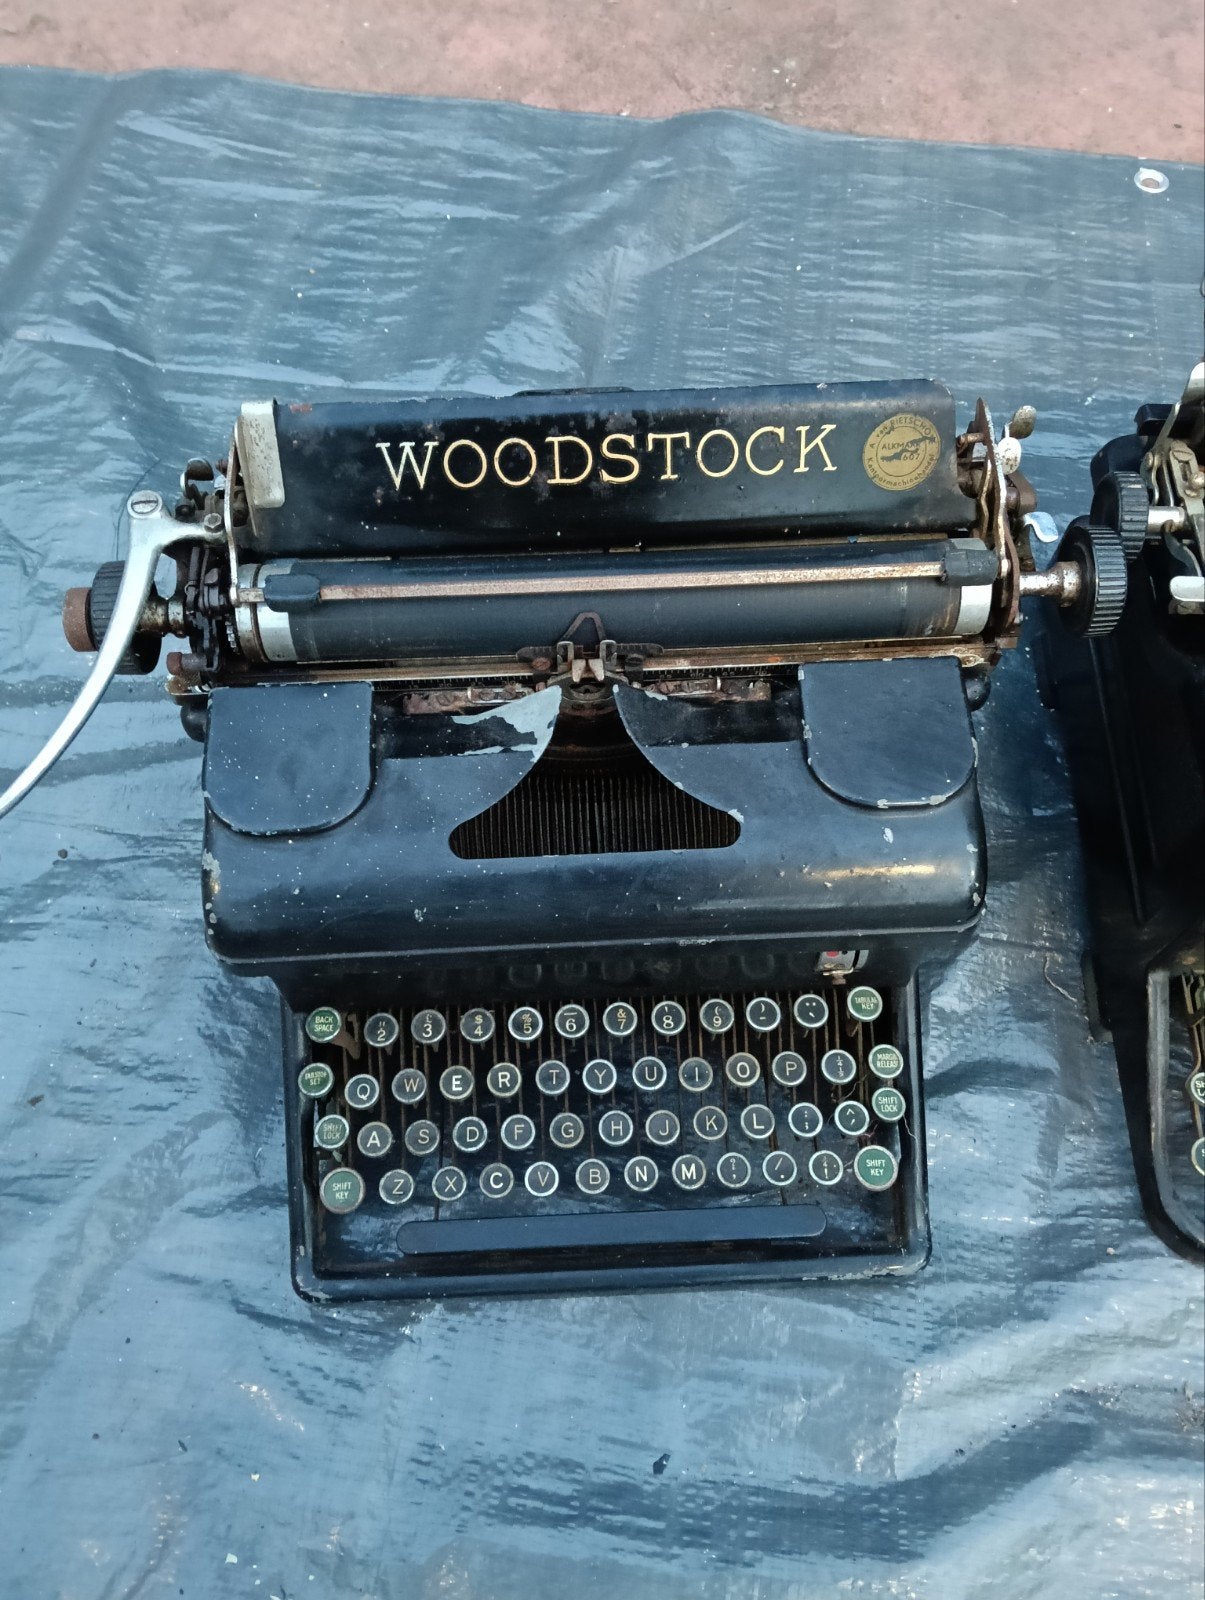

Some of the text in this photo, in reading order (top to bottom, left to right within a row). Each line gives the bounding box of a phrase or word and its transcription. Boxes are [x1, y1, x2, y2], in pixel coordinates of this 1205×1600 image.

[375, 424, 838, 491] WOODSTOCK
[315, 1015, 333, 1023] BACK
[565, 1018, 577, 1032] 6
[662, 1014, 674, 1029] 8
[713, 1015, 722, 1028] 9
[314, 1024, 334, 1032] SPACE
[422, 1024, 433, 1038] 3
[645, 1066, 657, 1082] U
[736, 1061, 750, 1078] O
[785, 1061, 798, 1076] P
[451, 1075, 463, 1091] E
[498, 1072, 511, 1088] R
[548, 1069, 560, 1085] T
[594, 1069, 607, 1085] Y
[356, 1083, 370, 1100] Q
[404, 1078, 420, 1093] W
[878, 1096, 898, 1105] SHIFT
[880, 1104, 898, 1112] LOCK
[611, 1120, 623, 1137] H
[659, 1119, 669, 1136] J
[705, 1115, 718, 1131] K
[752, 1113, 765, 1130] L
[323, 1132, 341, 1140] LOCK
[417, 1129, 430, 1145] S
[466, 1127, 479, 1143] D
[514, 1124, 525, 1141] F
[561, 1122, 575, 1138] G
[366, 1130, 381, 1148] A
[865, 1159, 886, 1167] SHIFT
[537, 1171, 550, 1187] V
[589, 1168, 602, 1185] B
[635, 1165, 648, 1183] N
[681, 1163, 697, 1181] M
[870, 1168, 884, 1177] KEY
[332, 1182, 352, 1191] SHIFT
[392, 1179, 405, 1195] Z
[444, 1176, 458, 1193] X
[489, 1172, 504, 1189] C
[335, 1191, 350, 1200] KEY
